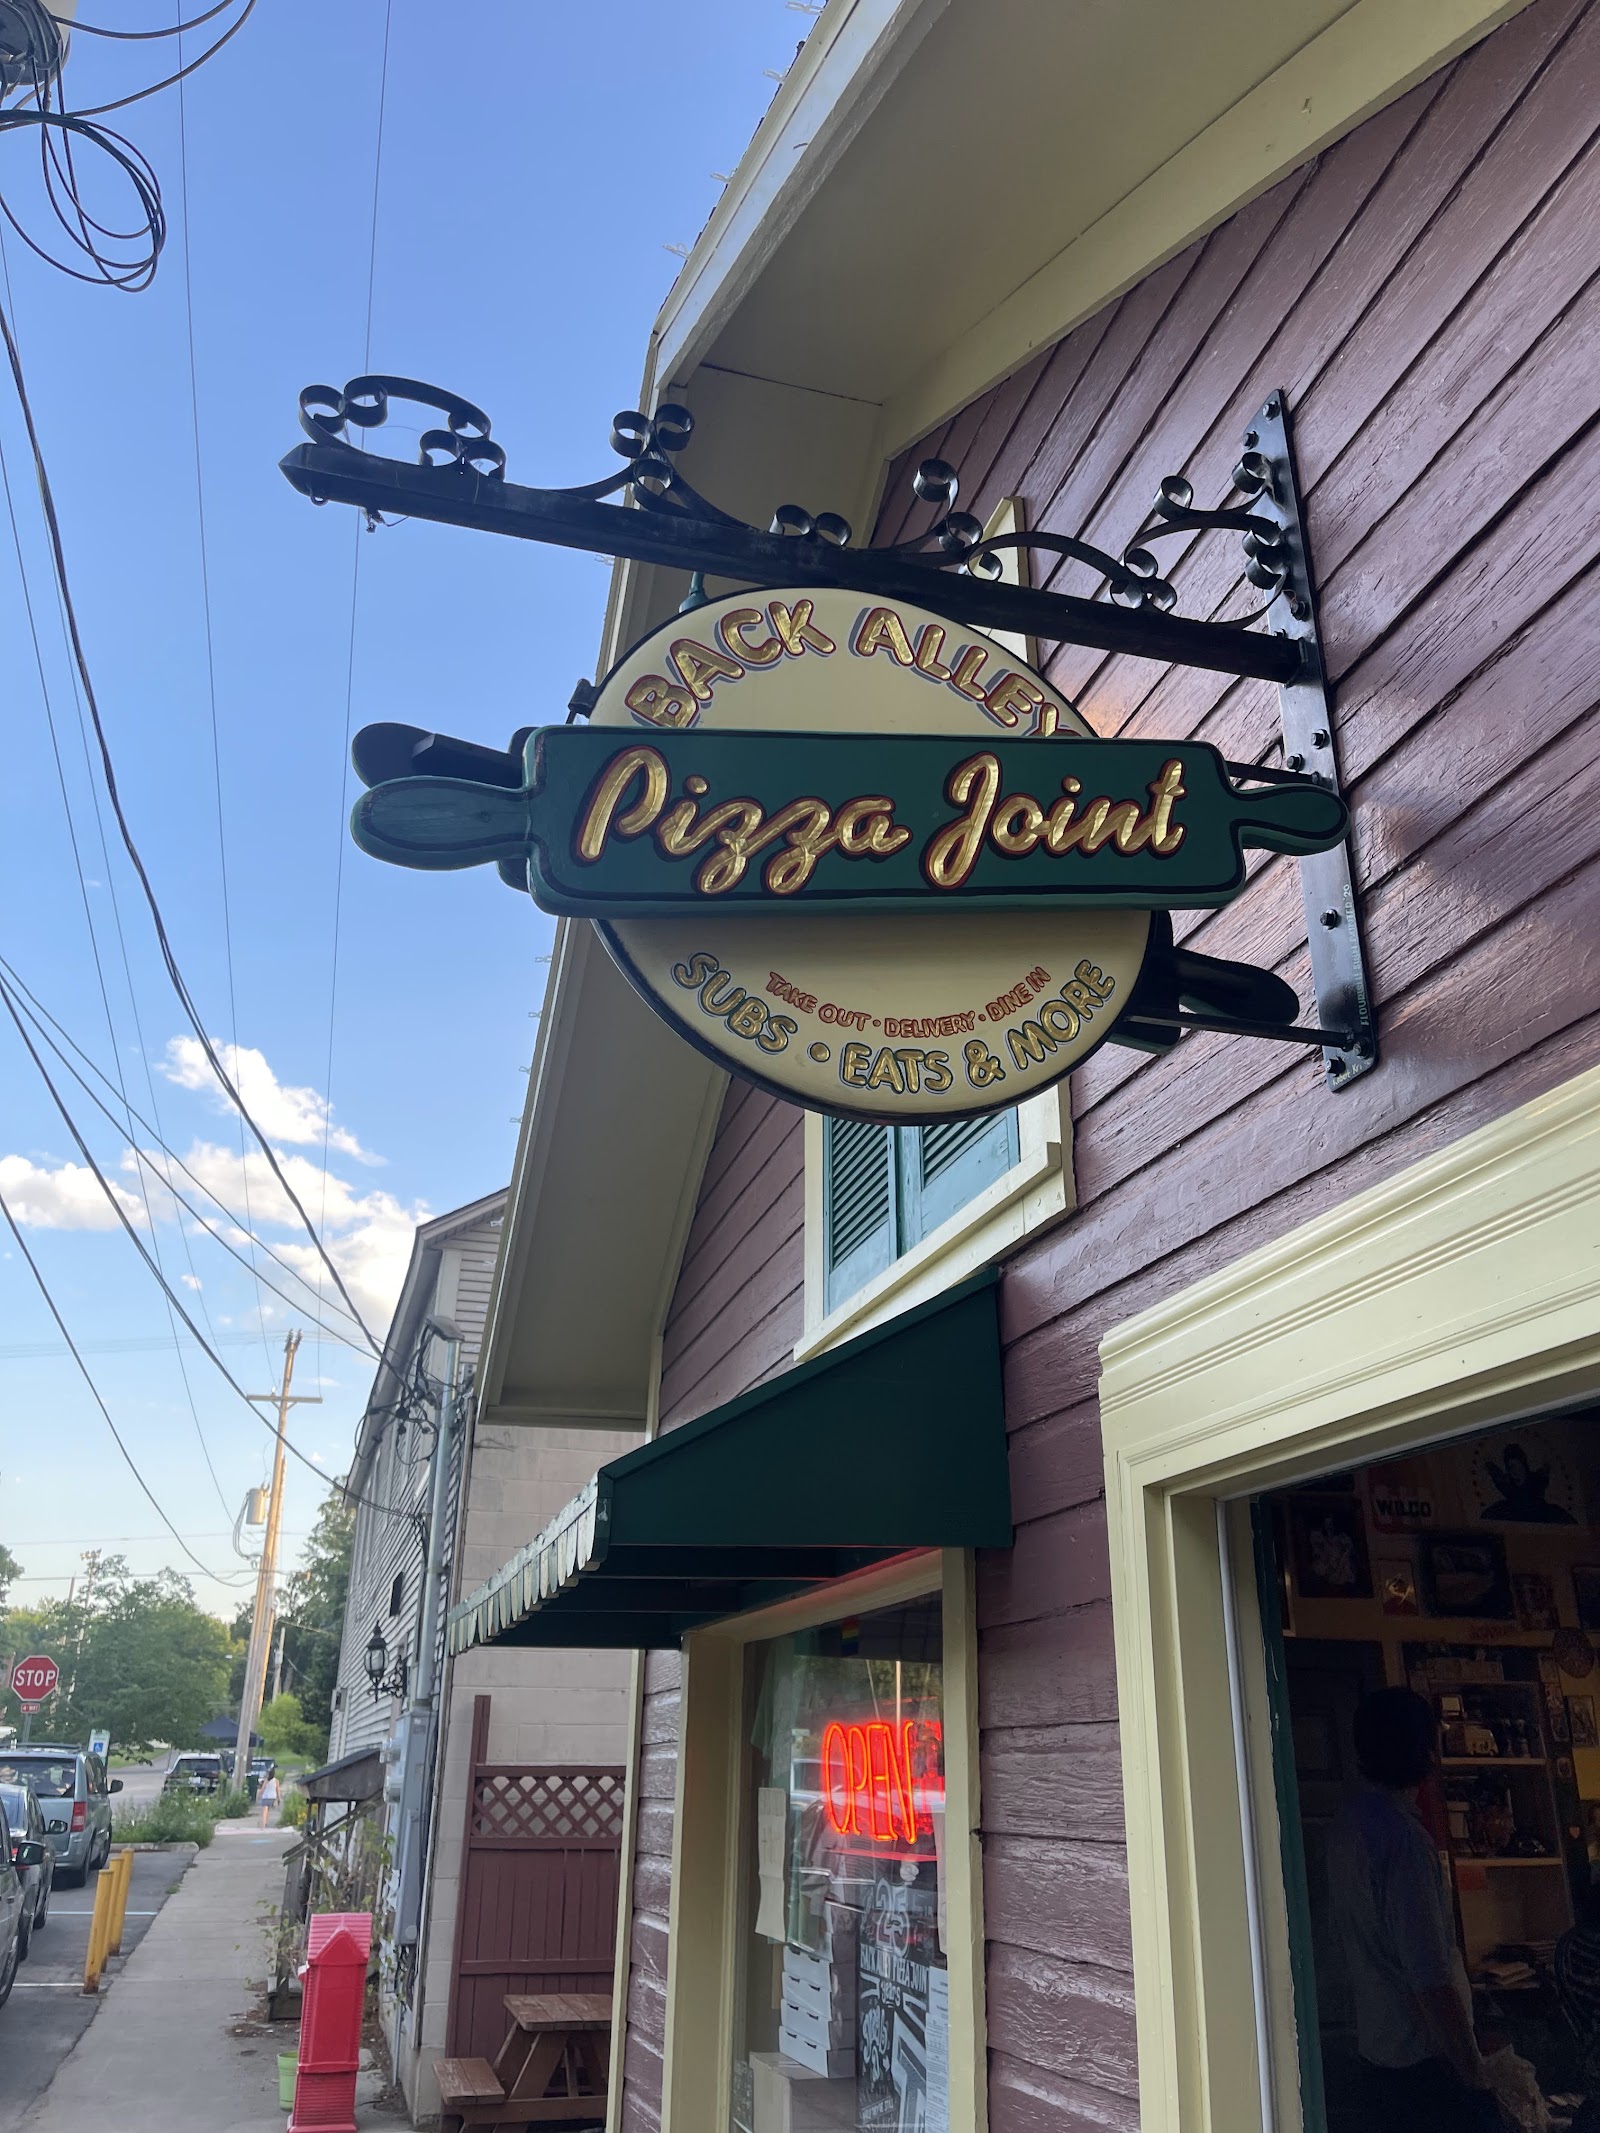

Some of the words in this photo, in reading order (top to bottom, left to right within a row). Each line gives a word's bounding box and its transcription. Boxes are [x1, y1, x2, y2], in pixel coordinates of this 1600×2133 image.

[624, 599, 837, 728] BACK
[576, 745, 911, 895] Pizza
[926, 751, 1186, 889] Joint
[672, 952, 798, 1053] SUBS
[843, 1042, 954, 1093] EATS
[964, 1039, 1006, 1087] &
[1006, 959, 1116, 1070] MORE
[766, 971, 818, 1014] TAKE
[818, 1003, 872, 1032] OUT
[884, 1010, 976, 1038] DELIVERY
[985, 982, 1035, 1022] DINE
[1025, 966, 1052, 993] IN
[16, 1670, 56, 1686] STOP
[824, 1720, 917, 1844] OPEN
